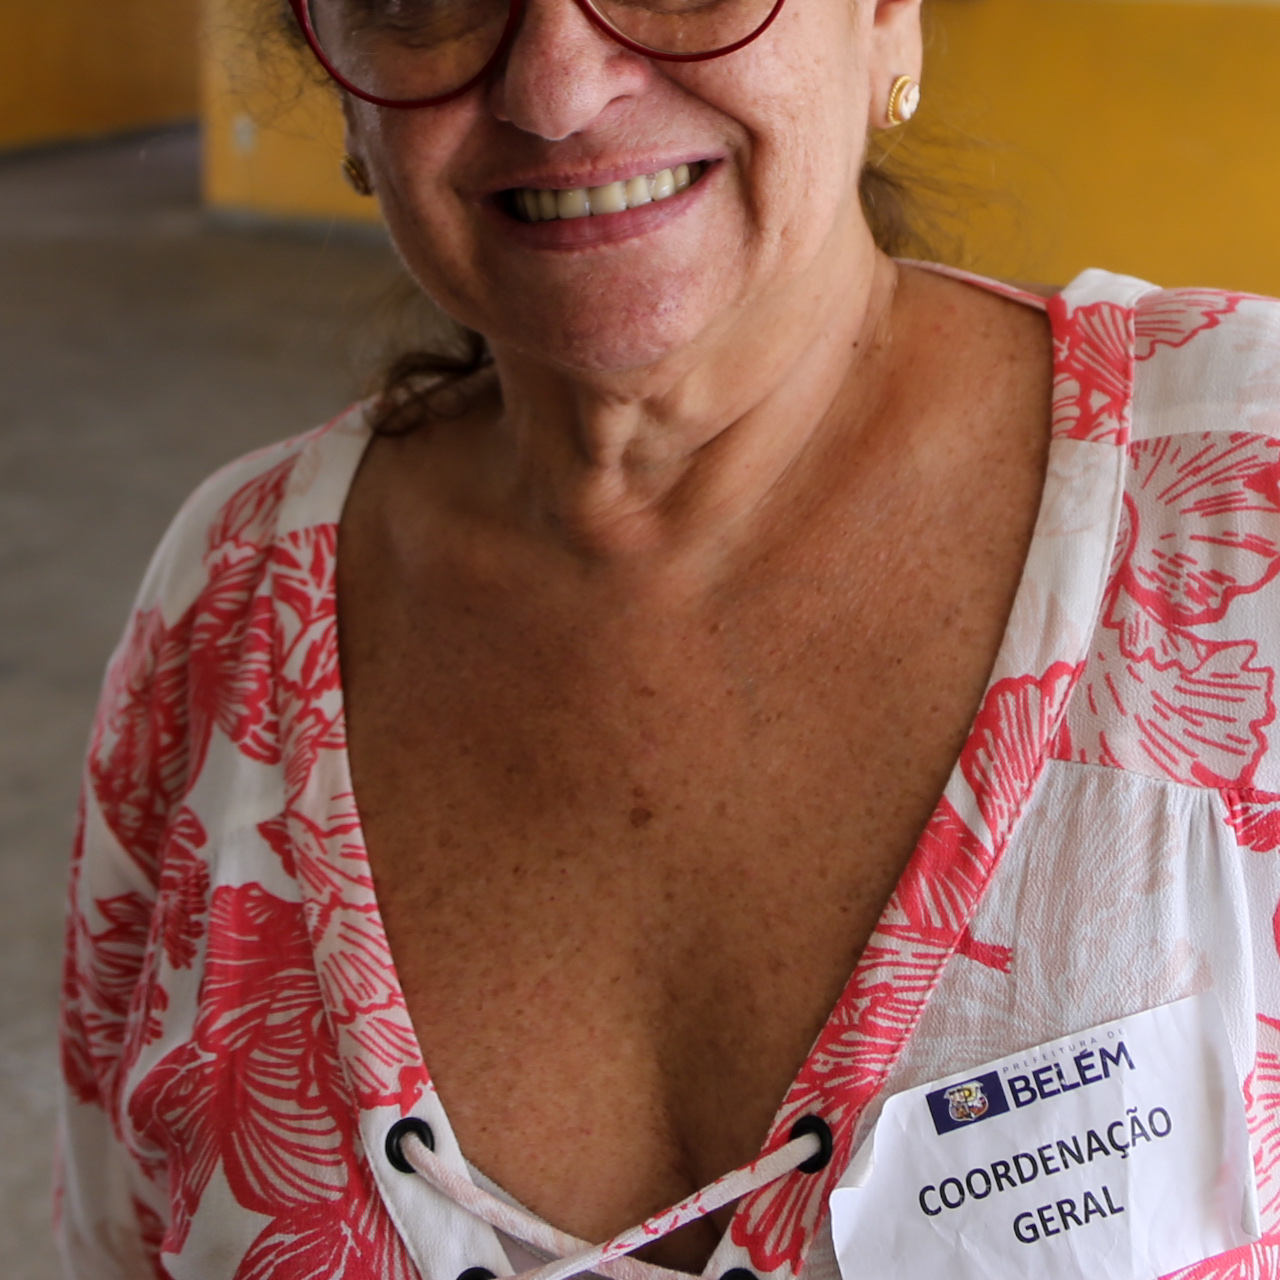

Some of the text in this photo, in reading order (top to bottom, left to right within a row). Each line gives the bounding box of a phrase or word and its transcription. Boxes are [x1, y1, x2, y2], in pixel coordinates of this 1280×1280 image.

[1002, 1036, 1099, 1074] PREFEITURA
[1007, 1041, 1135, 1108] BELÉM
[918, 1106, 1172, 1216] COORDENAÇÃO
[1013, 1186, 1124, 1244] GERAL
